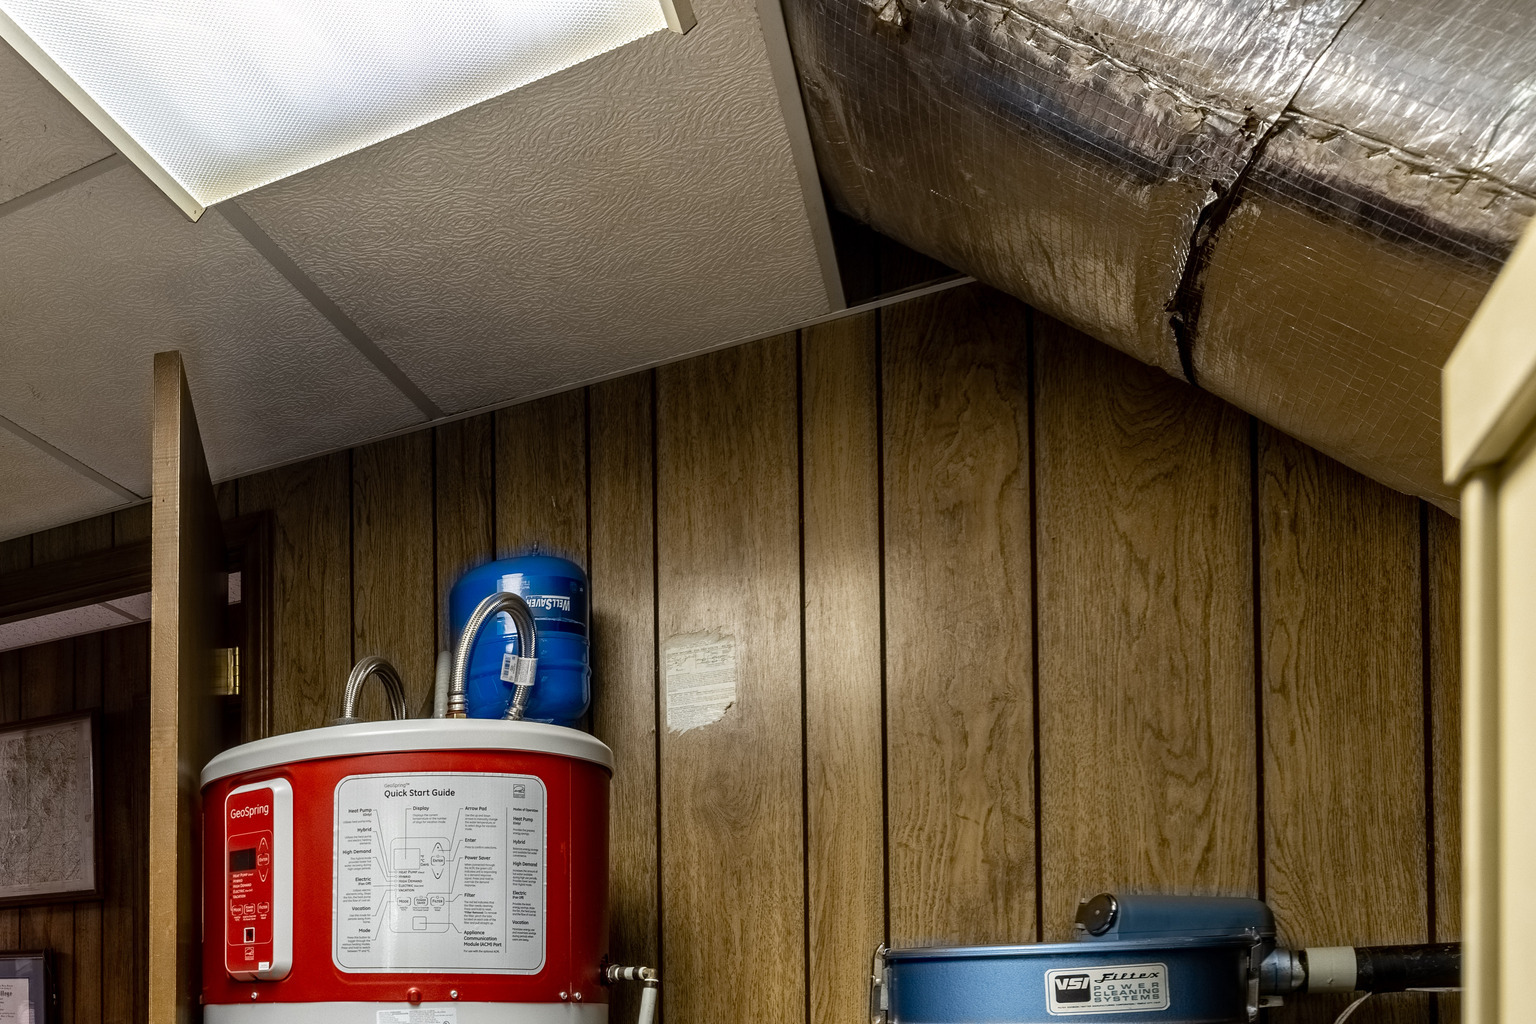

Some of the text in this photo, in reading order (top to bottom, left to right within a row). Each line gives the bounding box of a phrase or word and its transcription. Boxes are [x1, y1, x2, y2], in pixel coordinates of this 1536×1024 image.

[384, 790, 407, 798] Quick
[432, 788, 455, 796] Guide
[230, 804, 269, 819] GeoSpring
[1094, 972, 1160, 983] Filtex
[1055, 977, 1090, 990] VSI
[1094, 982, 1159, 991] POWER
[1094, 988, 1160, 998] CLEANING
[1094, 994, 1160, 1003] SYSTEMS
